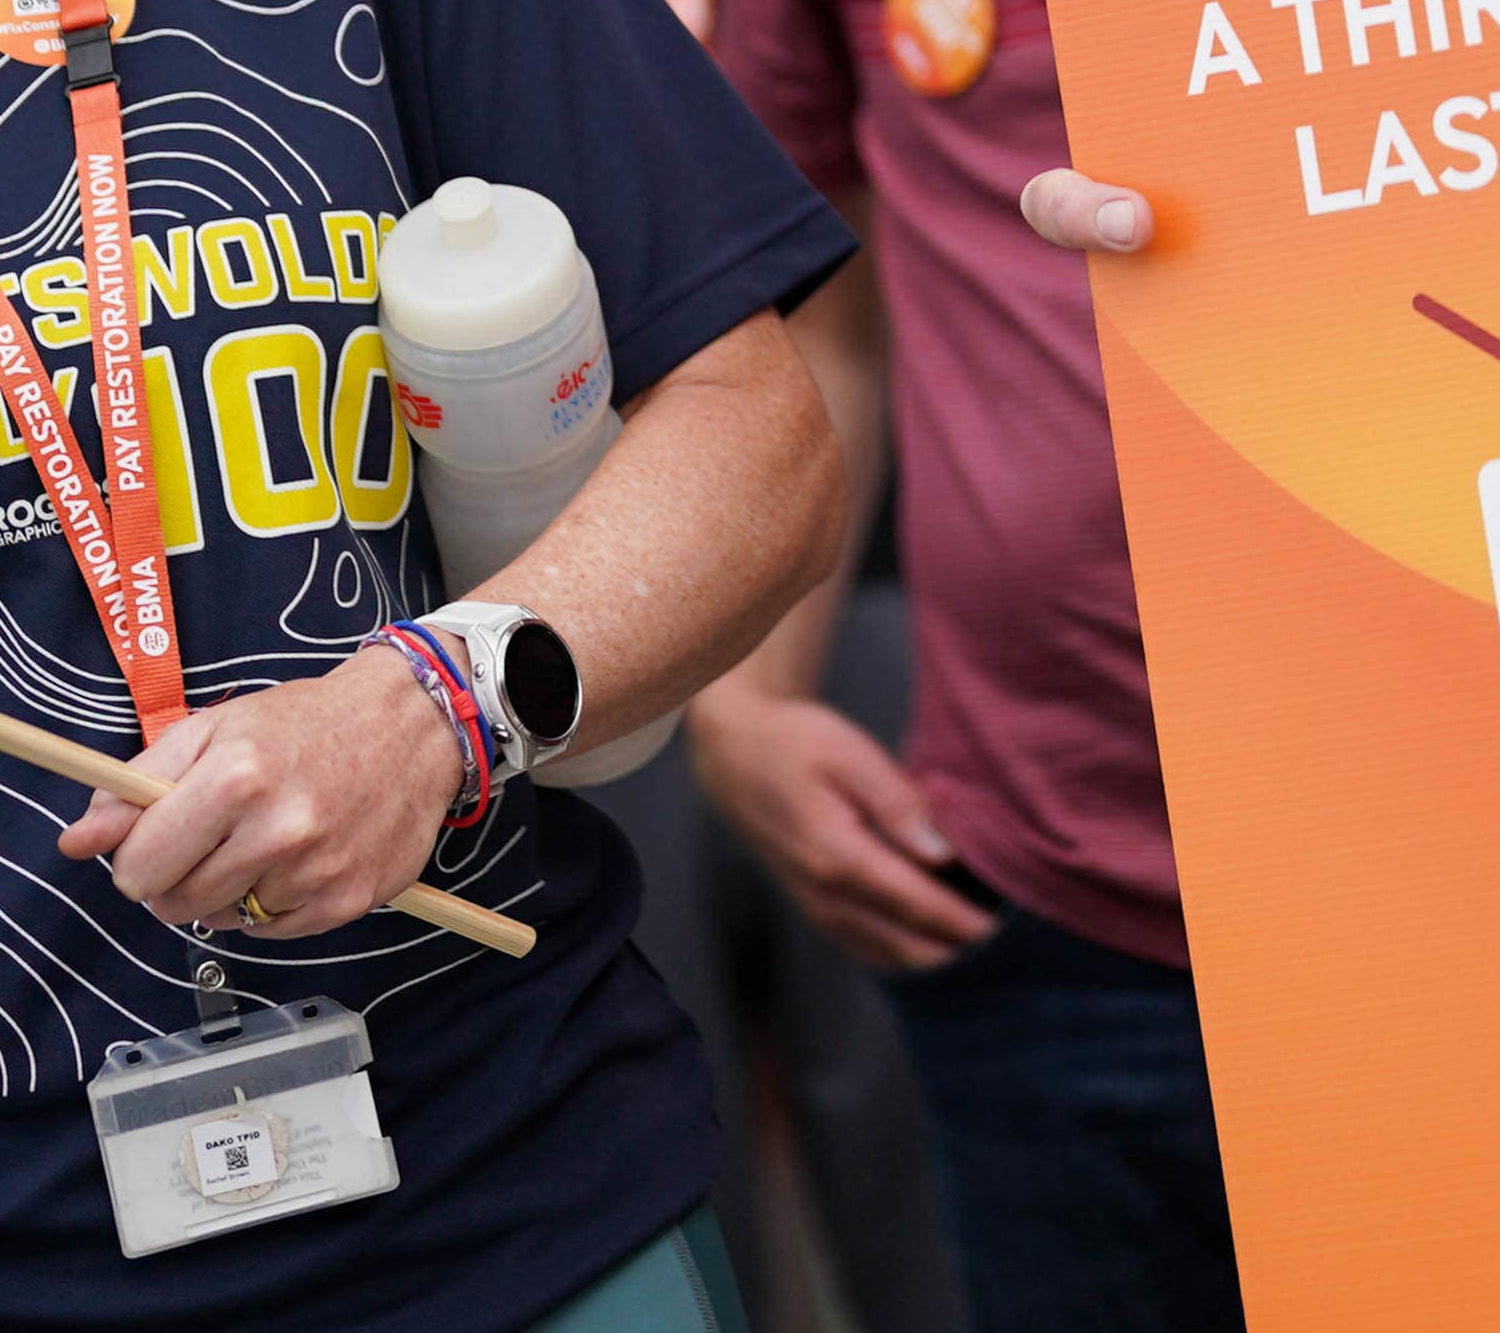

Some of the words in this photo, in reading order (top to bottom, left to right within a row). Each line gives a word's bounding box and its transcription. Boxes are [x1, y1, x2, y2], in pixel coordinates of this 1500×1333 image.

[1186, 1, 1263, 97] A
[88, 154, 118, 217] NOW
[94, 221, 141, 430] RESTORATION
[13, 377, 122, 586] RESTORATION
[119, 434, 146, 492] PAY
[128, 555, 165, 624] BMA
